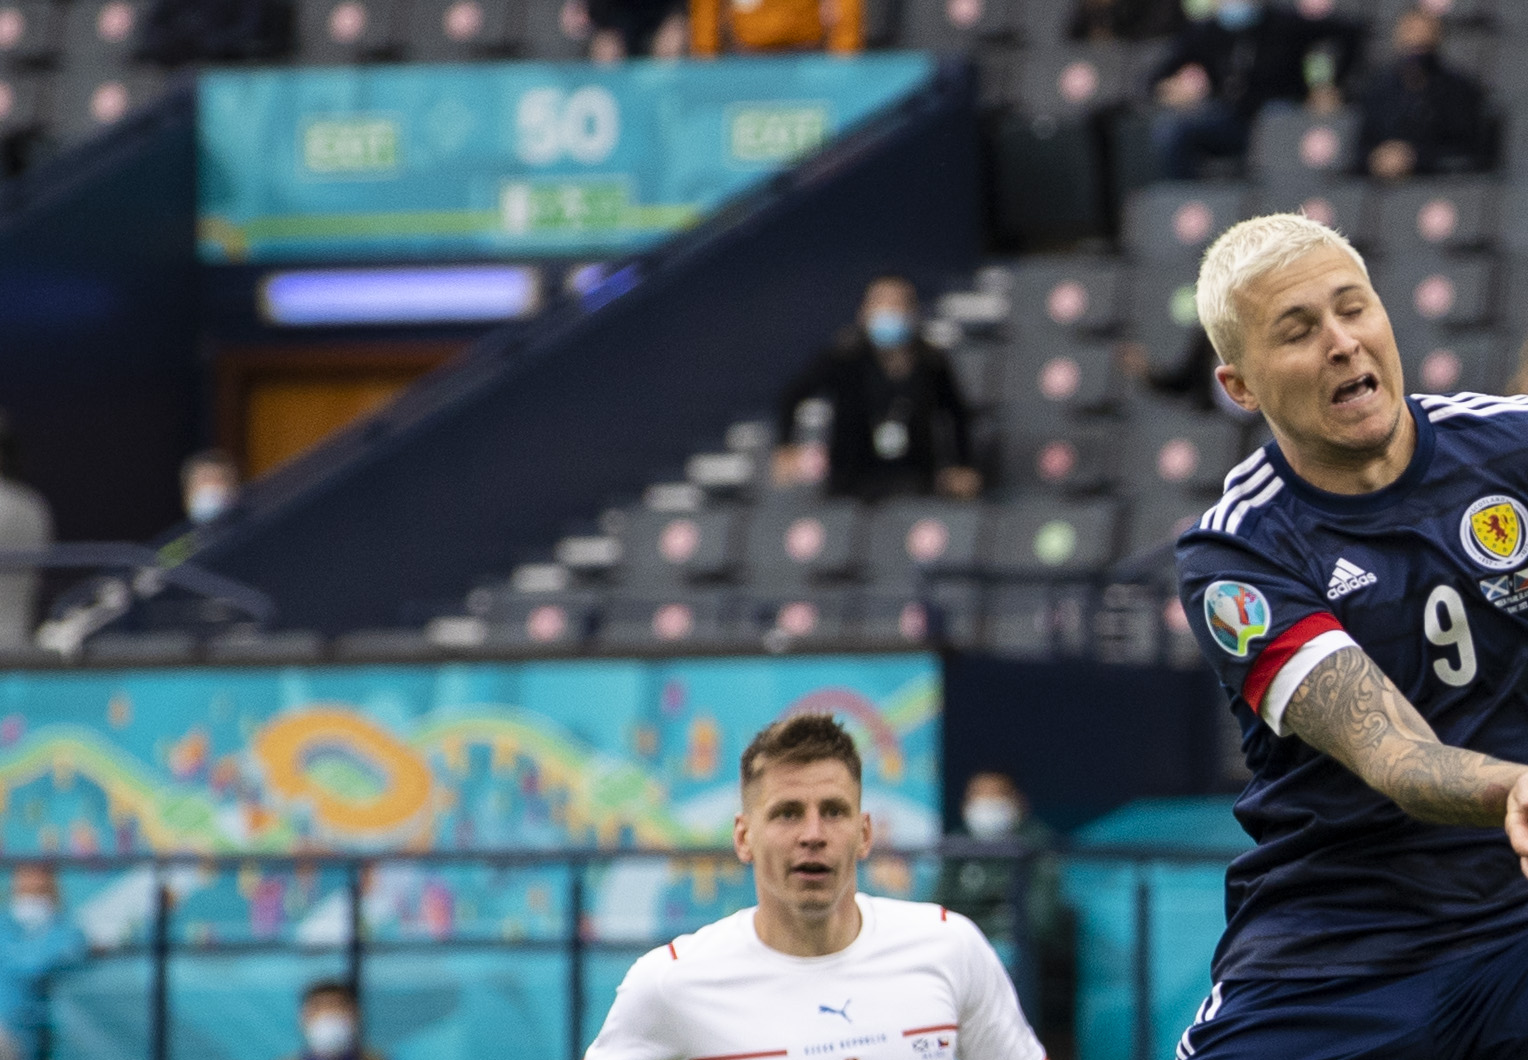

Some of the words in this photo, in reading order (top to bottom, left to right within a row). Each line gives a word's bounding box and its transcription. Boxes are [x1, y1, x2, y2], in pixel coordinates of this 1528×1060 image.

[516, 86, 620, 165] 50
[1326, 571, 1378, 600] adidas
[1424, 584, 1478, 687] 9
